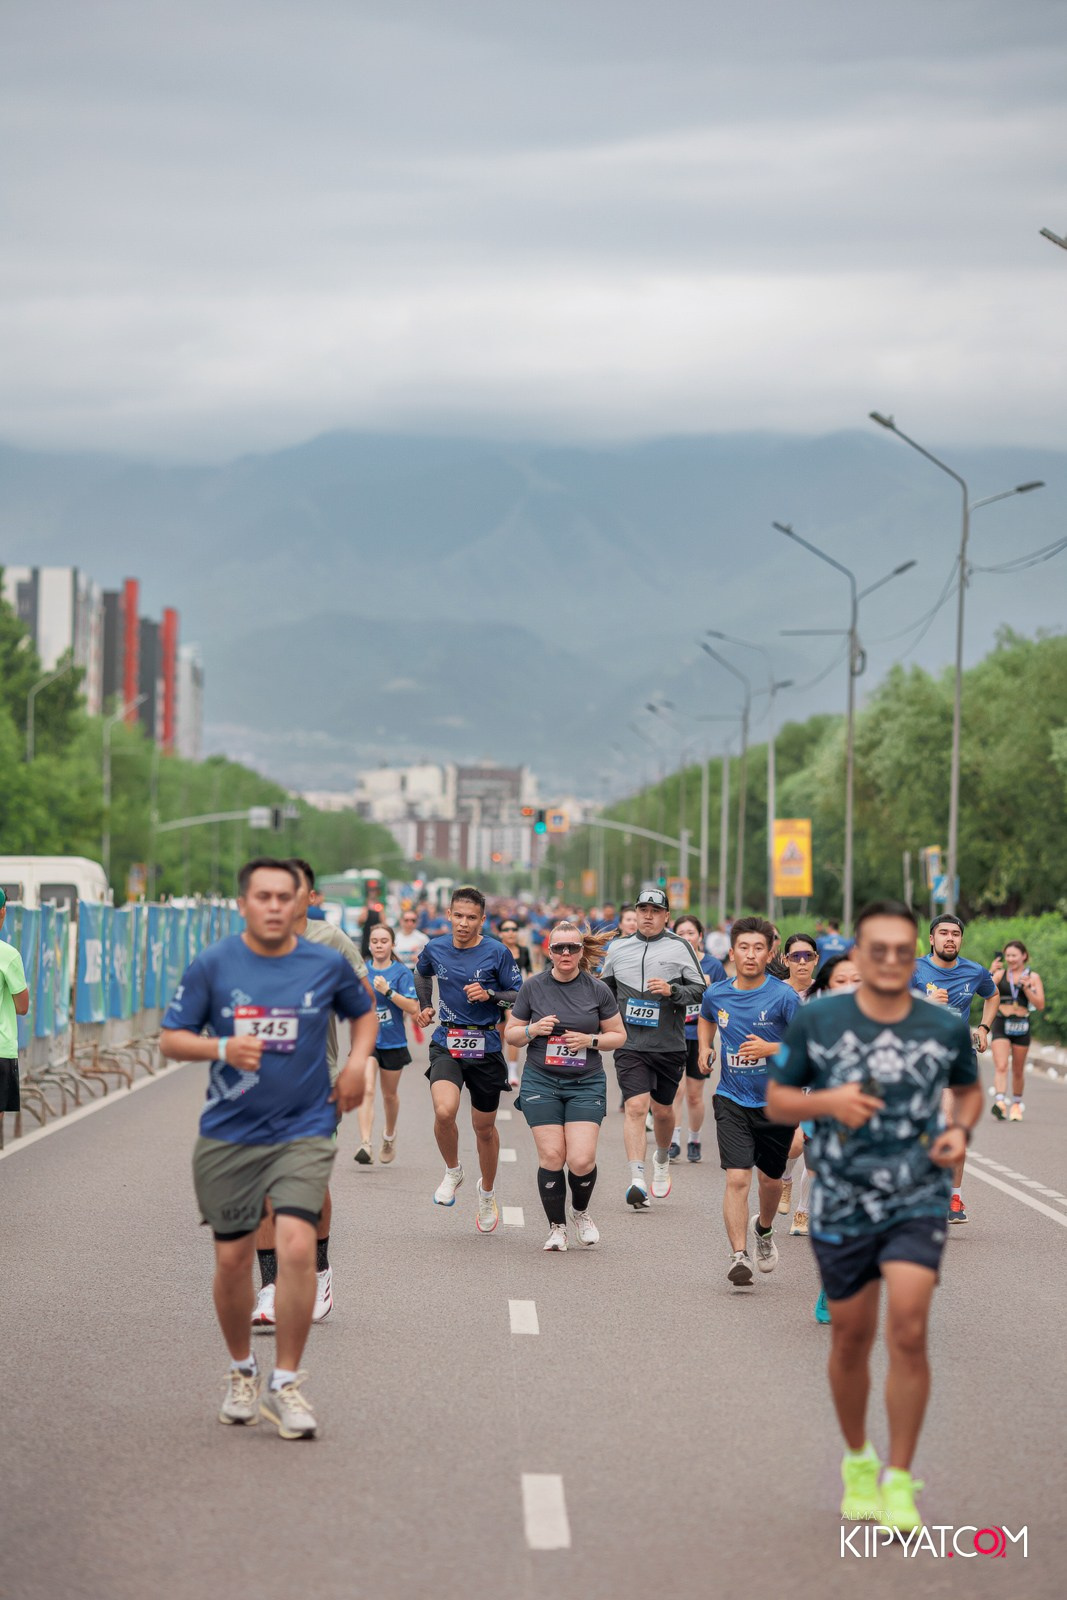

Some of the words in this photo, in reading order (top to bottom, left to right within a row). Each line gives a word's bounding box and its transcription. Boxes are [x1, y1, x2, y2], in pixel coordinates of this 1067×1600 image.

[629, 1007, 654, 1018] 1419
[248, 1021, 288, 1037] 345
[452, 1038, 478, 1049] 236
